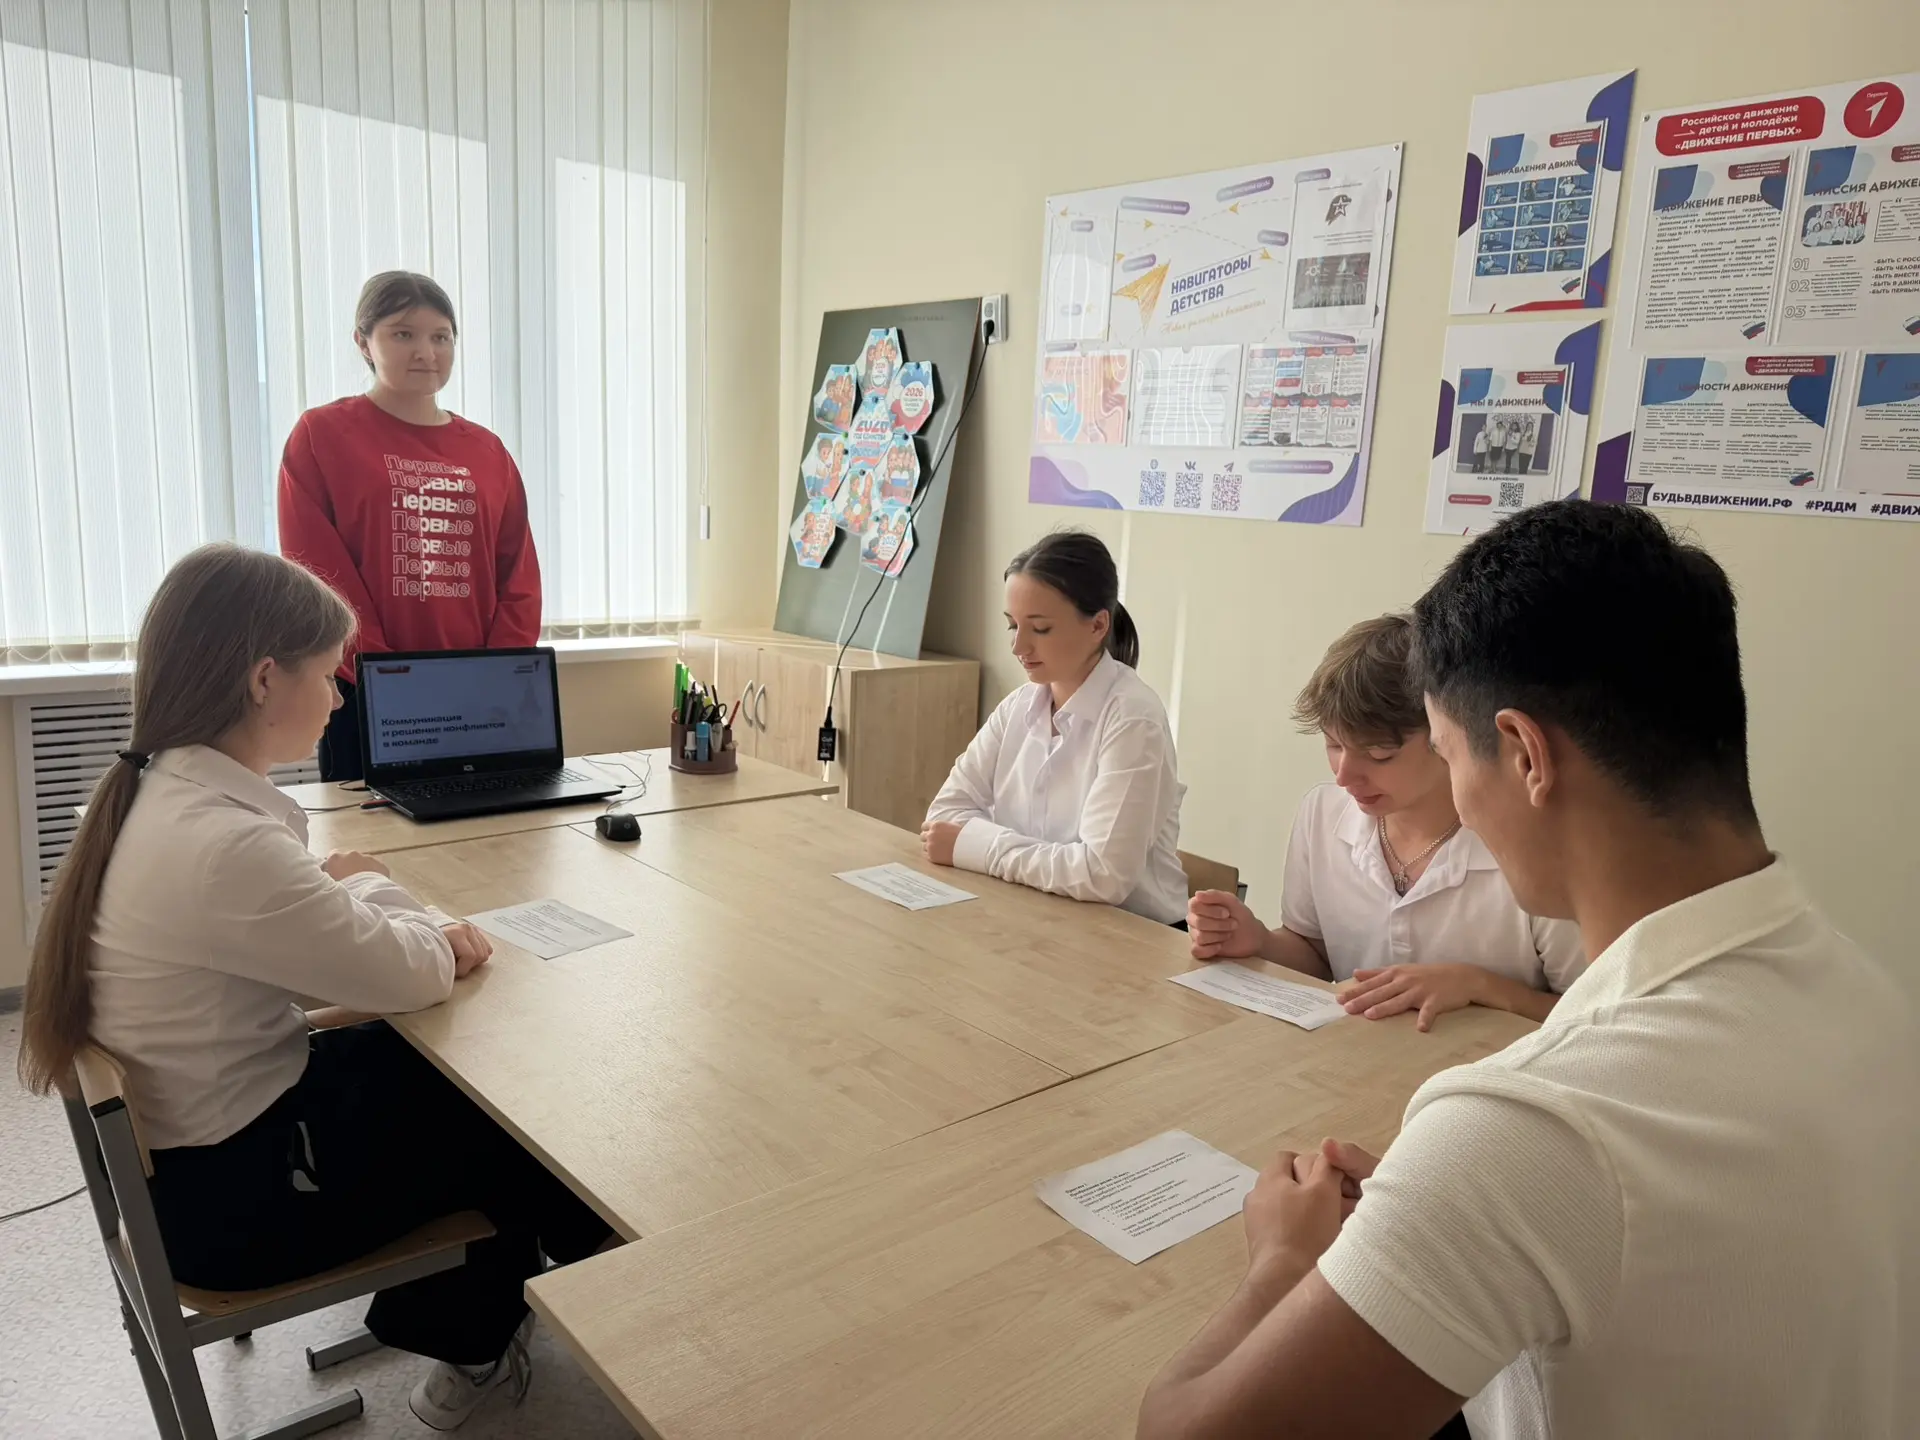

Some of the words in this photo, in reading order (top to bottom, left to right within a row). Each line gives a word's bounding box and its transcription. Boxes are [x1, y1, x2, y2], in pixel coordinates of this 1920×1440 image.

[1681, 112, 1741, 127] Российское
[1743, 103, 1799, 119] движение
[1698, 123, 1729, 136] детей
[1740, 113, 1798, 129] молодёжи
[1675, 133, 1743, 151] «ДВИЖЕНИЕ
[1746, 126, 1802, 141] ПЕРВЫХ»
[1171, 255, 1251, 294] НАВИГАТОРЫ
[1792, 258, 1810, 271] 01
[1789, 279, 1810, 292] 02
[1170, 284, 1224, 316] ДЕТСТВА
[1784, 305, 1807, 318] 03
[384, 454, 471, 476] Первые
[389, 470, 476, 493] Первые
[392, 488, 476, 516] Первые
[1651, 490, 1793, 508] БУДЬВДВИЖЕНИИ.РФ
[1805, 500, 1857, 514] #РДДМ
[392, 511, 473, 537] Первые
[392, 533, 471, 558] Первые
[392, 555, 470, 580] Первые
[393, 576, 470, 601] Первые
[391, 727, 441, 737] решение
[391, 738, 439, 747] команде
